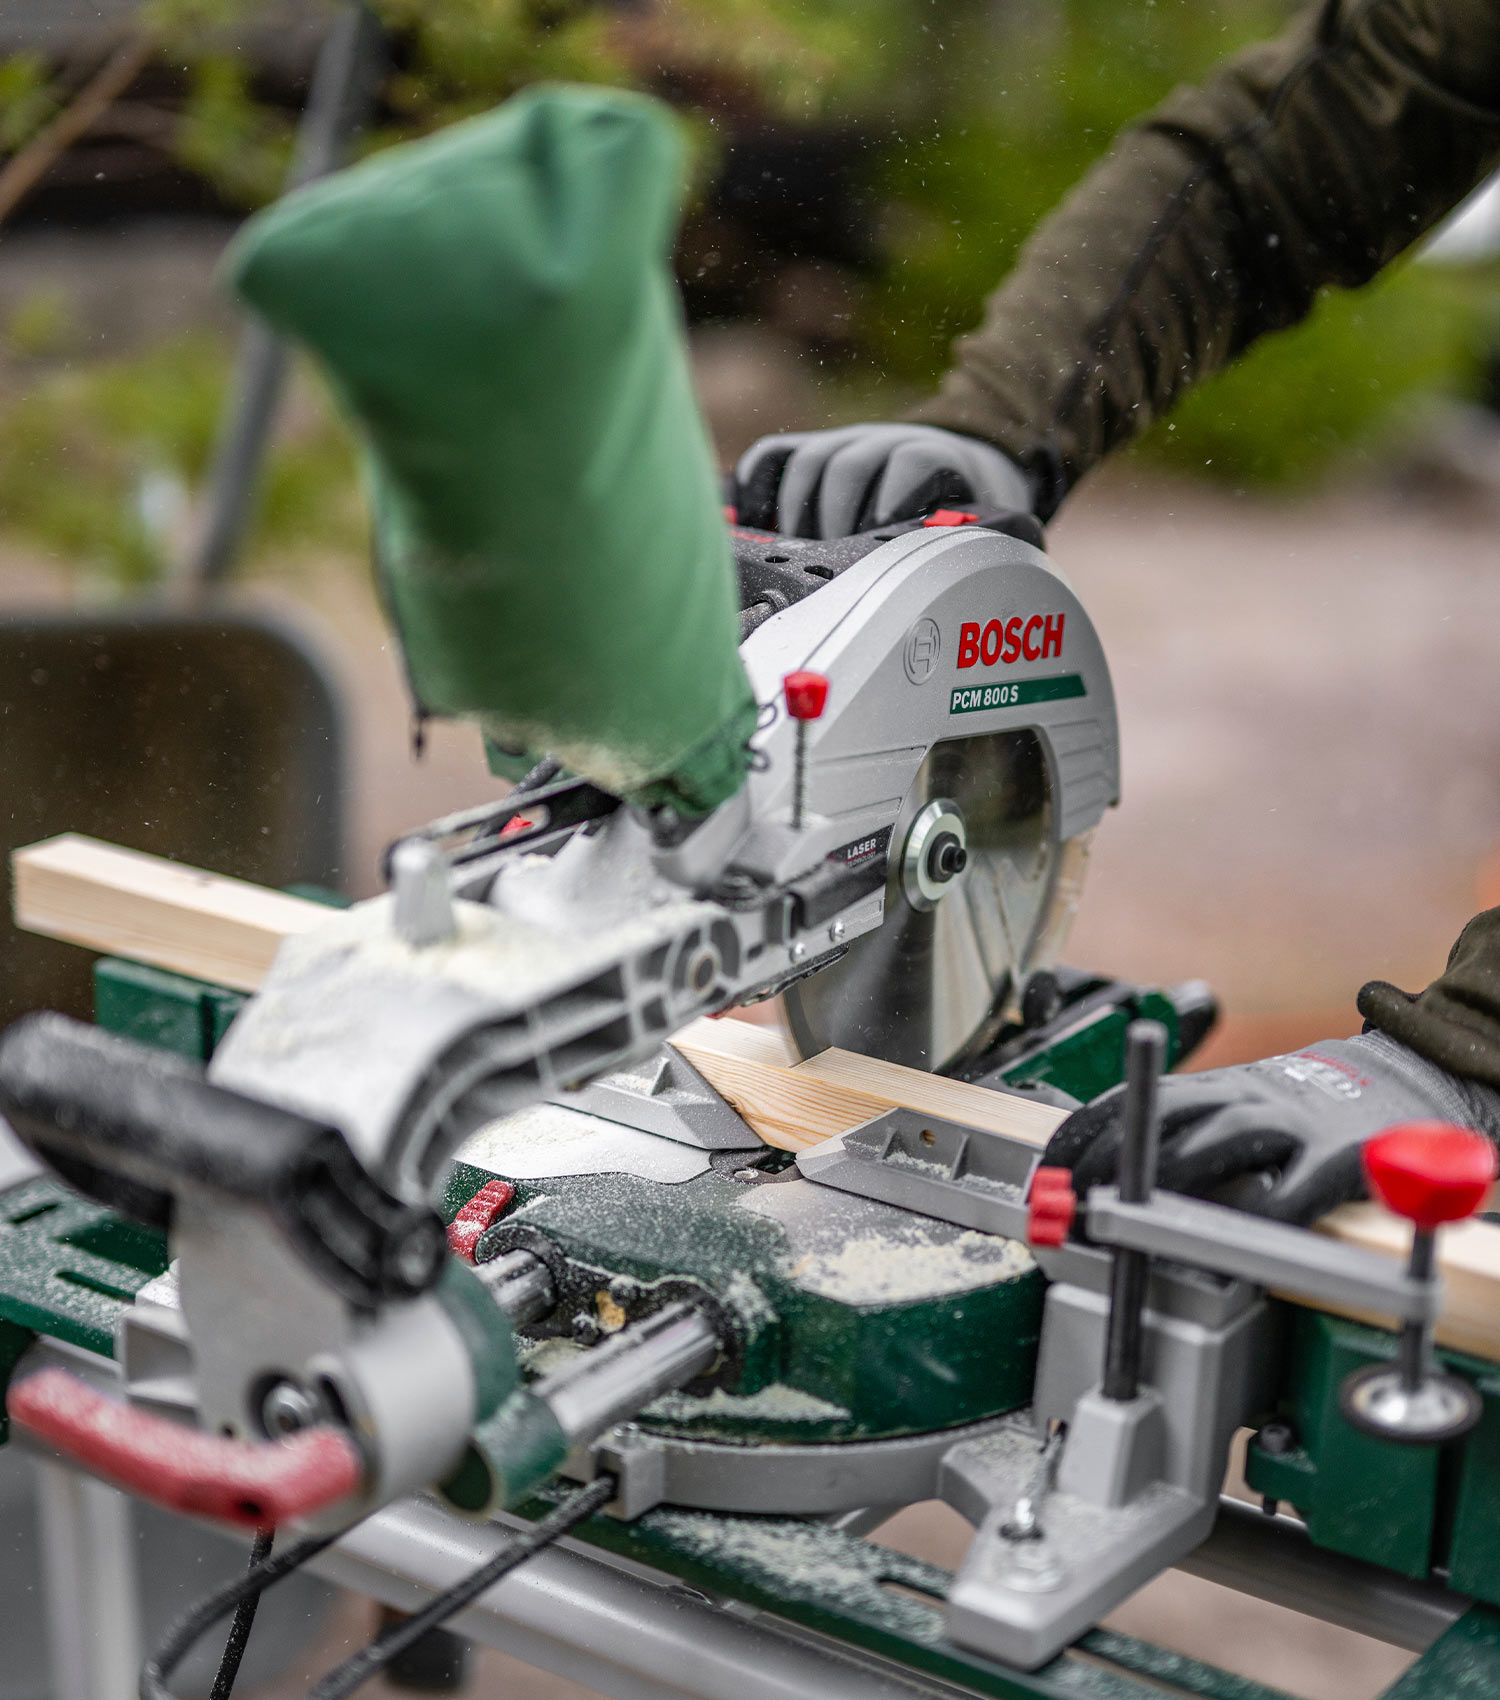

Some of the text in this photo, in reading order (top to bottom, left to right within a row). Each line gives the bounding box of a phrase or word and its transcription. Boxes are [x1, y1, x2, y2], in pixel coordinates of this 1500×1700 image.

[956, 613, 1065, 668] BOSCH
[952, 689, 982, 710] PCM
[847, 838, 876, 859] LASER
